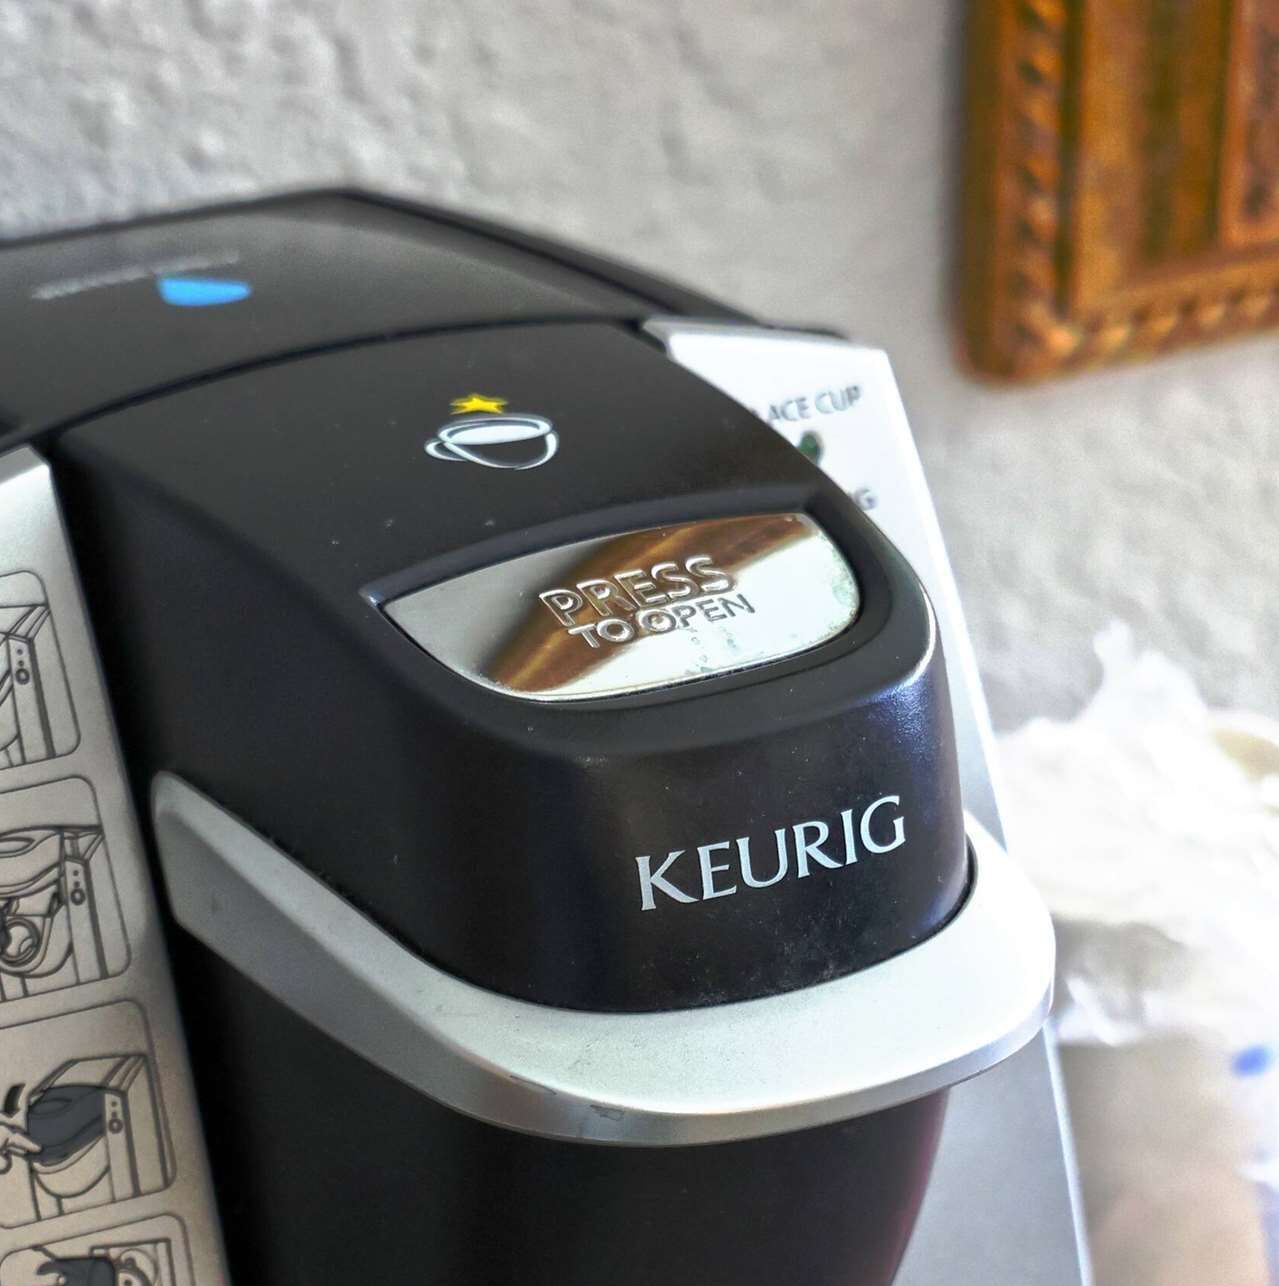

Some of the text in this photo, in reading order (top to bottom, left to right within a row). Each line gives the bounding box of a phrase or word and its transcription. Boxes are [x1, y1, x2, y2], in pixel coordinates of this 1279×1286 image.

[814, 384, 861, 414] CUP
[539, 555, 736, 626] PRESS
[568, 593, 755, 648] TO OPEN
[635, 795, 906, 911] KEURIG
